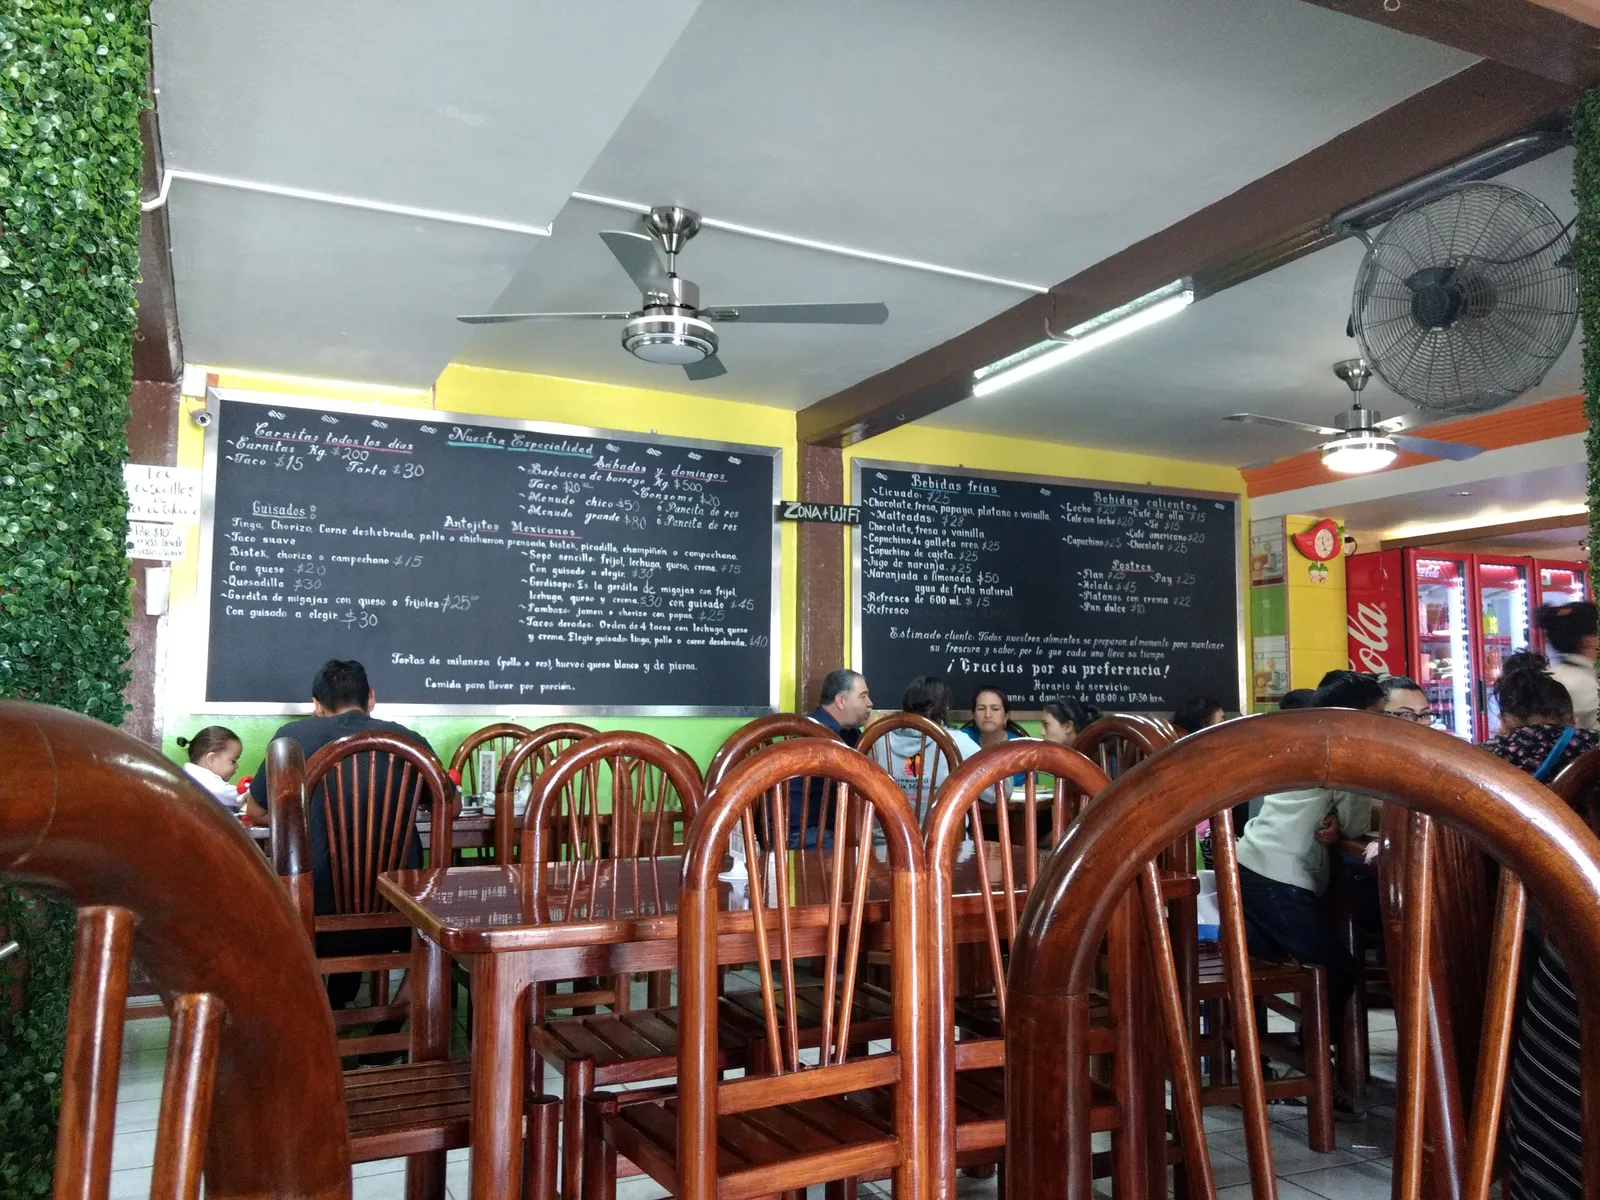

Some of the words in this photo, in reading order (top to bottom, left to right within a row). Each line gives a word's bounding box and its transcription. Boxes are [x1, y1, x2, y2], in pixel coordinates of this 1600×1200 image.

[254, 422, 319, 442] Carnitas
[326, 432, 358, 445] todos
[364, 437, 380, 448] los
[449, 426, 505, 445] Nuestra
[510, 433, 593, 455] Especialidad
[234, 453, 266, 466] Taco
[275, 455, 303, 471] $15
[346, 460, 387, 476] Torta
[392, 463, 424, 478] $30
[528, 463, 586, 480] Barbacoa
[589, 472, 602, 481] de
[606, 473, 645, 487] borrego
[655, 468, 663, 478] y
[671, 465, 725, 482] domingos
[912, 474, 961, 491] Bebidas
[528, 492, 575, 505] Menudo
[585, 498, 613, 508] chico
[666, 503, 704, 516] Pancita
[710, 507, 719, 517] de
[724, 509, 739, 518] res
[1067, 502, 1092, 513] Leche
[1093, 492, 1139, 508] Bebidas
[1147, 499, 1198, 511] calientes
[528, 505, 573, 518] Menudo
[584, 511, 620, 524] grande
[664, 516, 702, 529] Pancita
[708, 519, 718, 529] de
[723, 522, 737, 531] res
[784, 502, 822, 520] ZONA
[444, 515, 500, 534] Antojitos
[511, 521, 575, 536] Mexicanos
[231, 532, 256, 542] Taco
[263, 537, 296, 545] suave
[277, 551, 312, 560] chorizo
[332, 554, 389, 566] campechano
[393, 555, 423, 567] $15
[530, 550, 551, 563] Sope
[869, 545, 910, 558] Capuchino
[914, 549, 923, 558] de
[230, 561, 247, 572] Con
[255, 567, 284, 576] queso
[294, 563, 326, 575] $20
[530, 563, 546, 573] Con
[552, 567, 585, 578] guisado
[868, 558, 888, 569] Jugo
[893, 558, 903, 568] de
[1112, 560, 1151, 571] Postres
[1082, 570, 1104, 579] Flan
[229, 575, 284, 587] Quesadilla
[294, 579, 322, 591] $30
[915, 585, 935, 594] agua
[940, 585, 950, 593] de
[953, 585, 975, 594] fruta
[980, 586, 1013, 597] natural
[867, 591, 909, 603] Refresco
[915, 595, 924, 603] de
[930, 596, 946, 605] 600
[226, 606, 244, 615] Con
[250, 607, 287, 619] guisado
[867, 604, 909, 615] Refresco
[1083, 602, 1100, 611] Pan
[1104, 605, 1126, 613] dulce
[526, 616, 554, 627] Tacos
[600, 620, 626, 630] Orden
[629, 622, 638, 630] de
[640, 622, 646, 630] 4
[650, 622, 671, 631] tacos
[728, 628, 748, 636] queso
[890, 626, 941, 640] Estimado
[978, 632, 1002, 642] Todos
[1348, 602, 1389, 674] ola
[392, 652, 425, 665] Tortas
[429, 656, 440, 665] de
[447, 655, 489, 666] milanesa
[587, 662, 610, 671] queso
[614, 660, 639, 669] blanco
[643, 662, 650, 673] y
[654, 660, 664, 670] de
[1032, 663, 1054, 676] por
[1062, 664, 1077, 674] su
[425, 677, 461, 689] Comida
[466, 681, 485, 692] para
[489, 680, 513, 689] llevar
[520, 683, 534, 694] por
[1033, 679, 1070, 691] Horario
[1076, 681, 1084, 690] de
[1081, 693, 1089, 701] de
